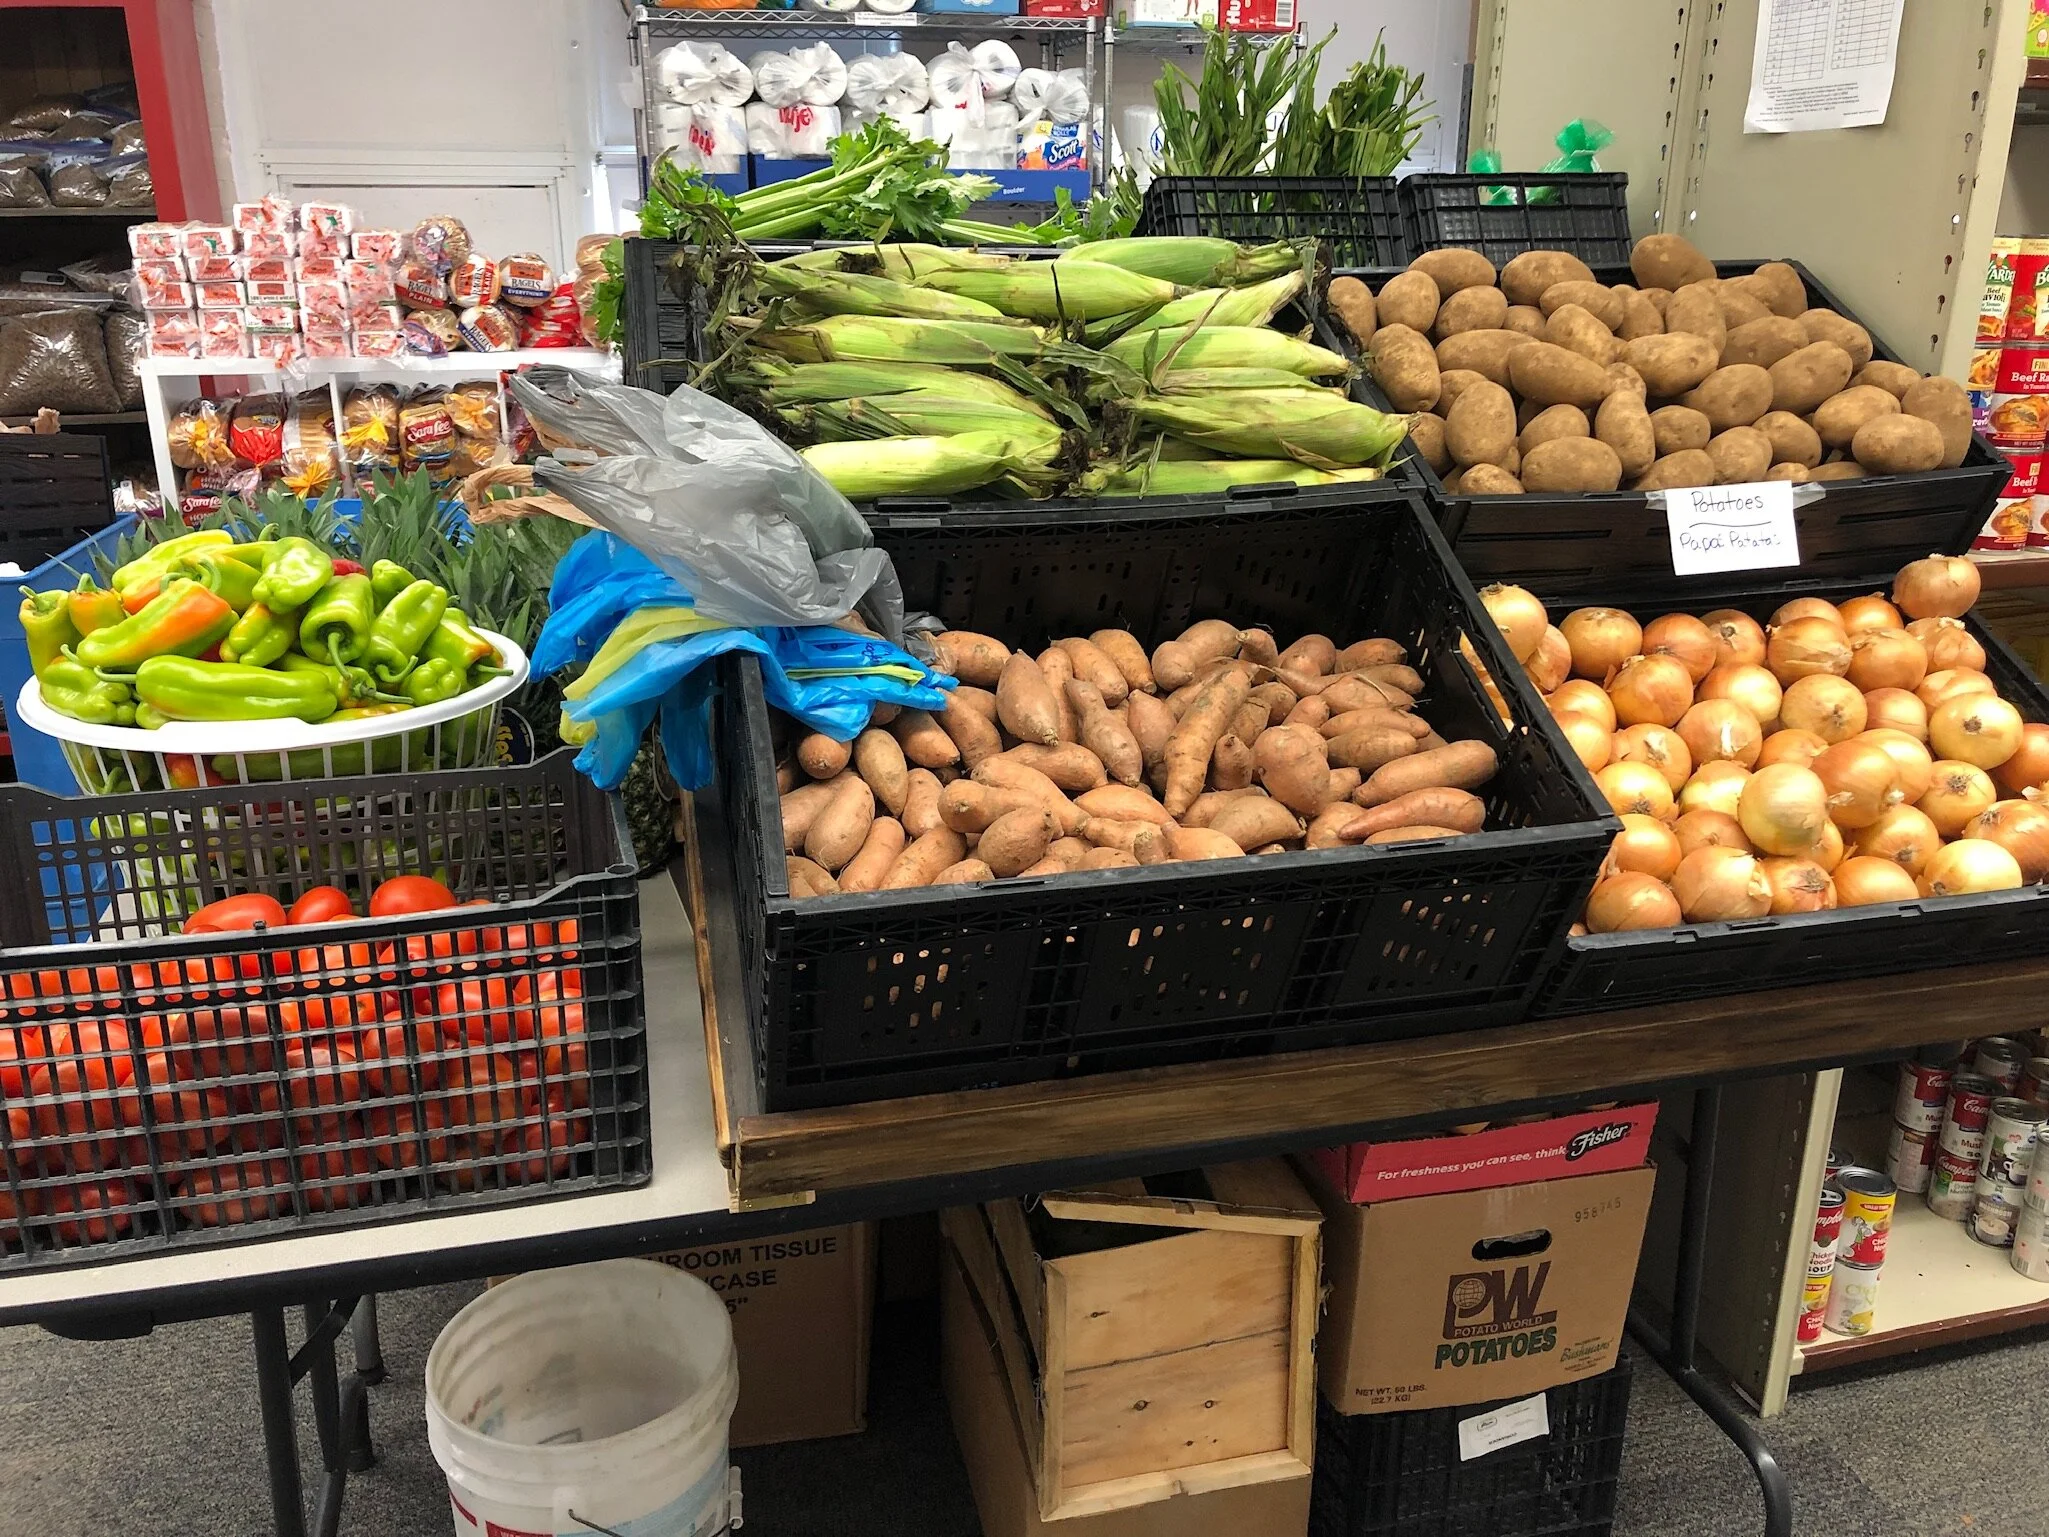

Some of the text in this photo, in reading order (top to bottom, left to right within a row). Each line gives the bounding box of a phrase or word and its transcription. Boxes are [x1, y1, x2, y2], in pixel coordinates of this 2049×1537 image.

[1049, 139, 1079, 163] Scott
[508, 288, 544, 298] EVERYTHING
[511, 278, 542, 290] BAGELS
[408, 292, 433, 305] PLAIN
[468, 326, 494, 352] BAGELS
[2011, 371, 2038, 383] Beef
[407, 420, 452, 442] Sara Lee
[2012, 476, 2032, 487] Beef
[183, 497, 208, 512] Sara
[1690, 490, 1764, 513] Potatoes
[1377, 1124, 1630, 1181] For freshness you can see, think Fisher
[749, 1237, 837, 1262] TISSUE
[703, 1269, 777, 1292] CASE
[1443, 1261, 1552, 1339] PW
[1454, 1316, 1543, 1337] POTATO WORLD
[1434, 1326, 1557, 1370] POTATOES
[1355, 1388, 1374, 1396] NET
[1376, 1387, 1392, 1395] WT.
